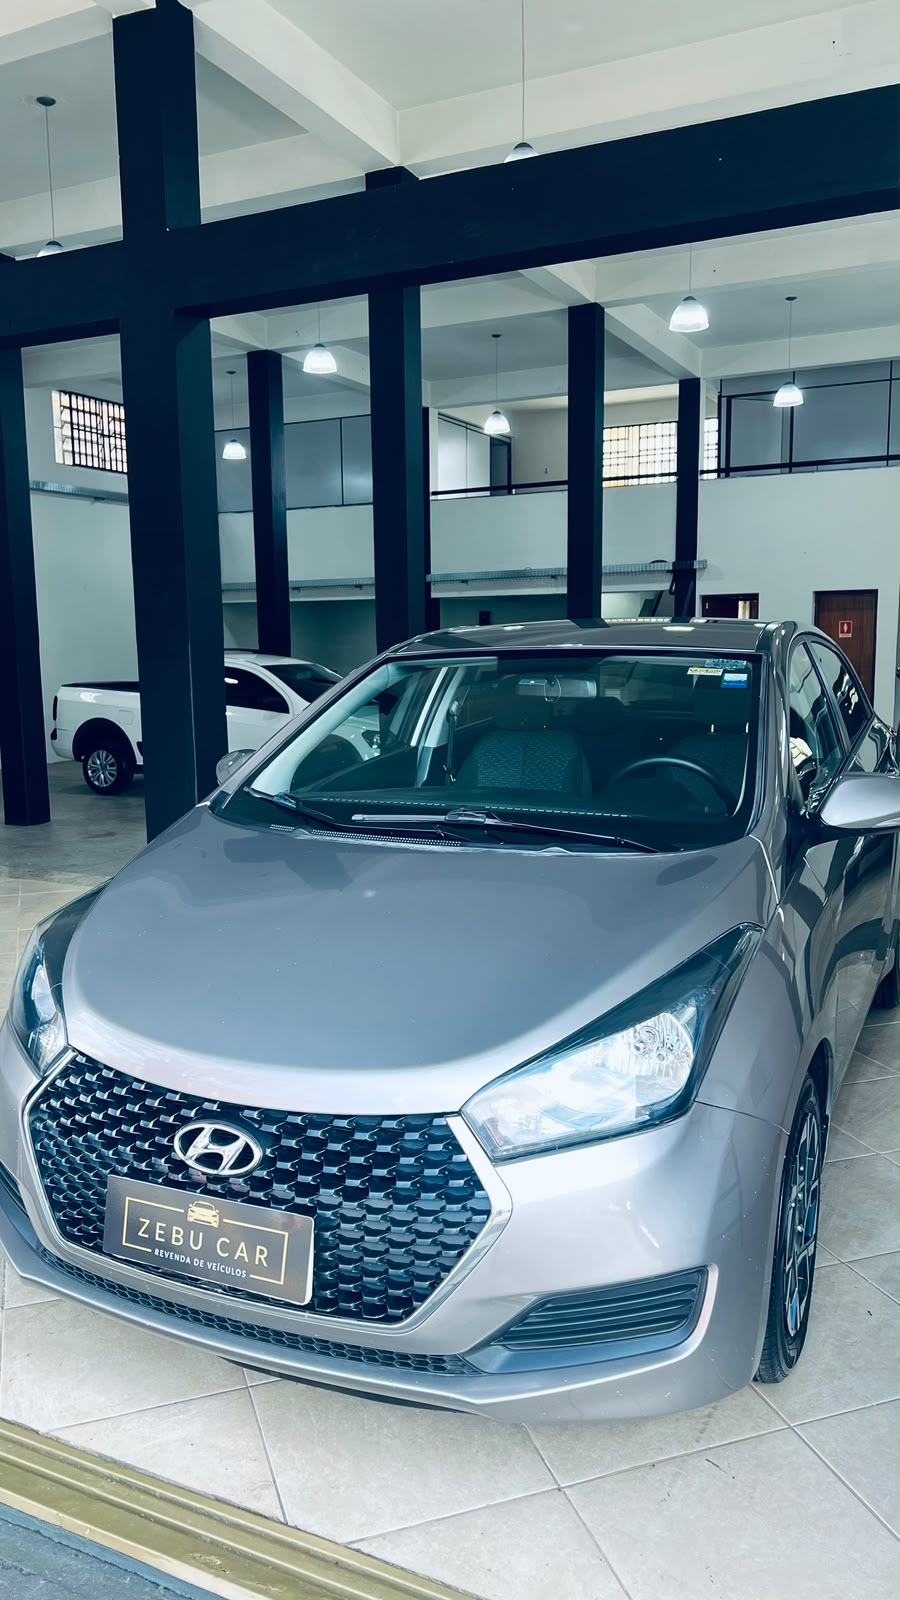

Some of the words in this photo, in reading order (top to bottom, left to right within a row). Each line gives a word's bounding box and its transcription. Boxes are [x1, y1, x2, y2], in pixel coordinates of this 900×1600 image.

[137, 1218, 204, 1250] ZEBU
[216, 1237, 268, 1267] CAR
[154, 1248, 191, 1265] REVENDA
[193, 1258, 205, 1268] DE
[207, 1261, 247, 1278] VEÍCULOS
